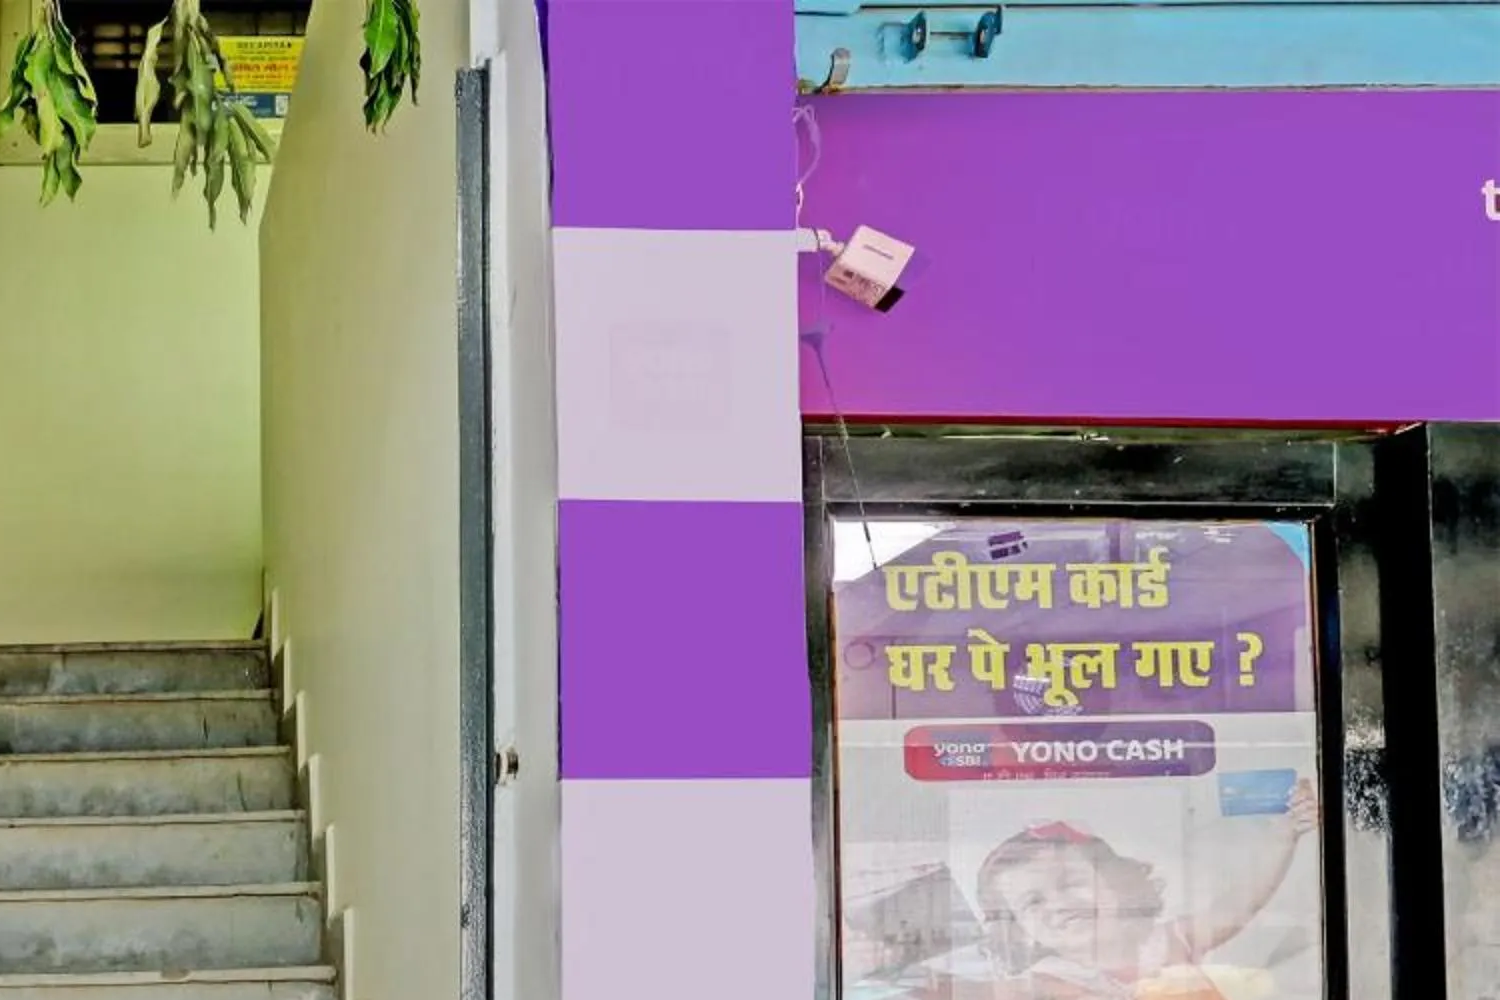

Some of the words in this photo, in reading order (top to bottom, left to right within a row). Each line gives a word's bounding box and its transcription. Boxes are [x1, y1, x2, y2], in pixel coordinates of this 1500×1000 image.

[884, 551, 1055, 611] एटीएम
[1067, 547, 1171, 609] कार्ड
[886, 644, 955, 691] घर
[968, 629, 1008, 690] पे
[1026, 640, 1120, 706] भूल
[1132, 640, 1215, 688] गए
[1236, 633, 1264, 687] ?
[1012, 740, 1099, 763] YONO
[1106, 738, 1184, 761] CASH
